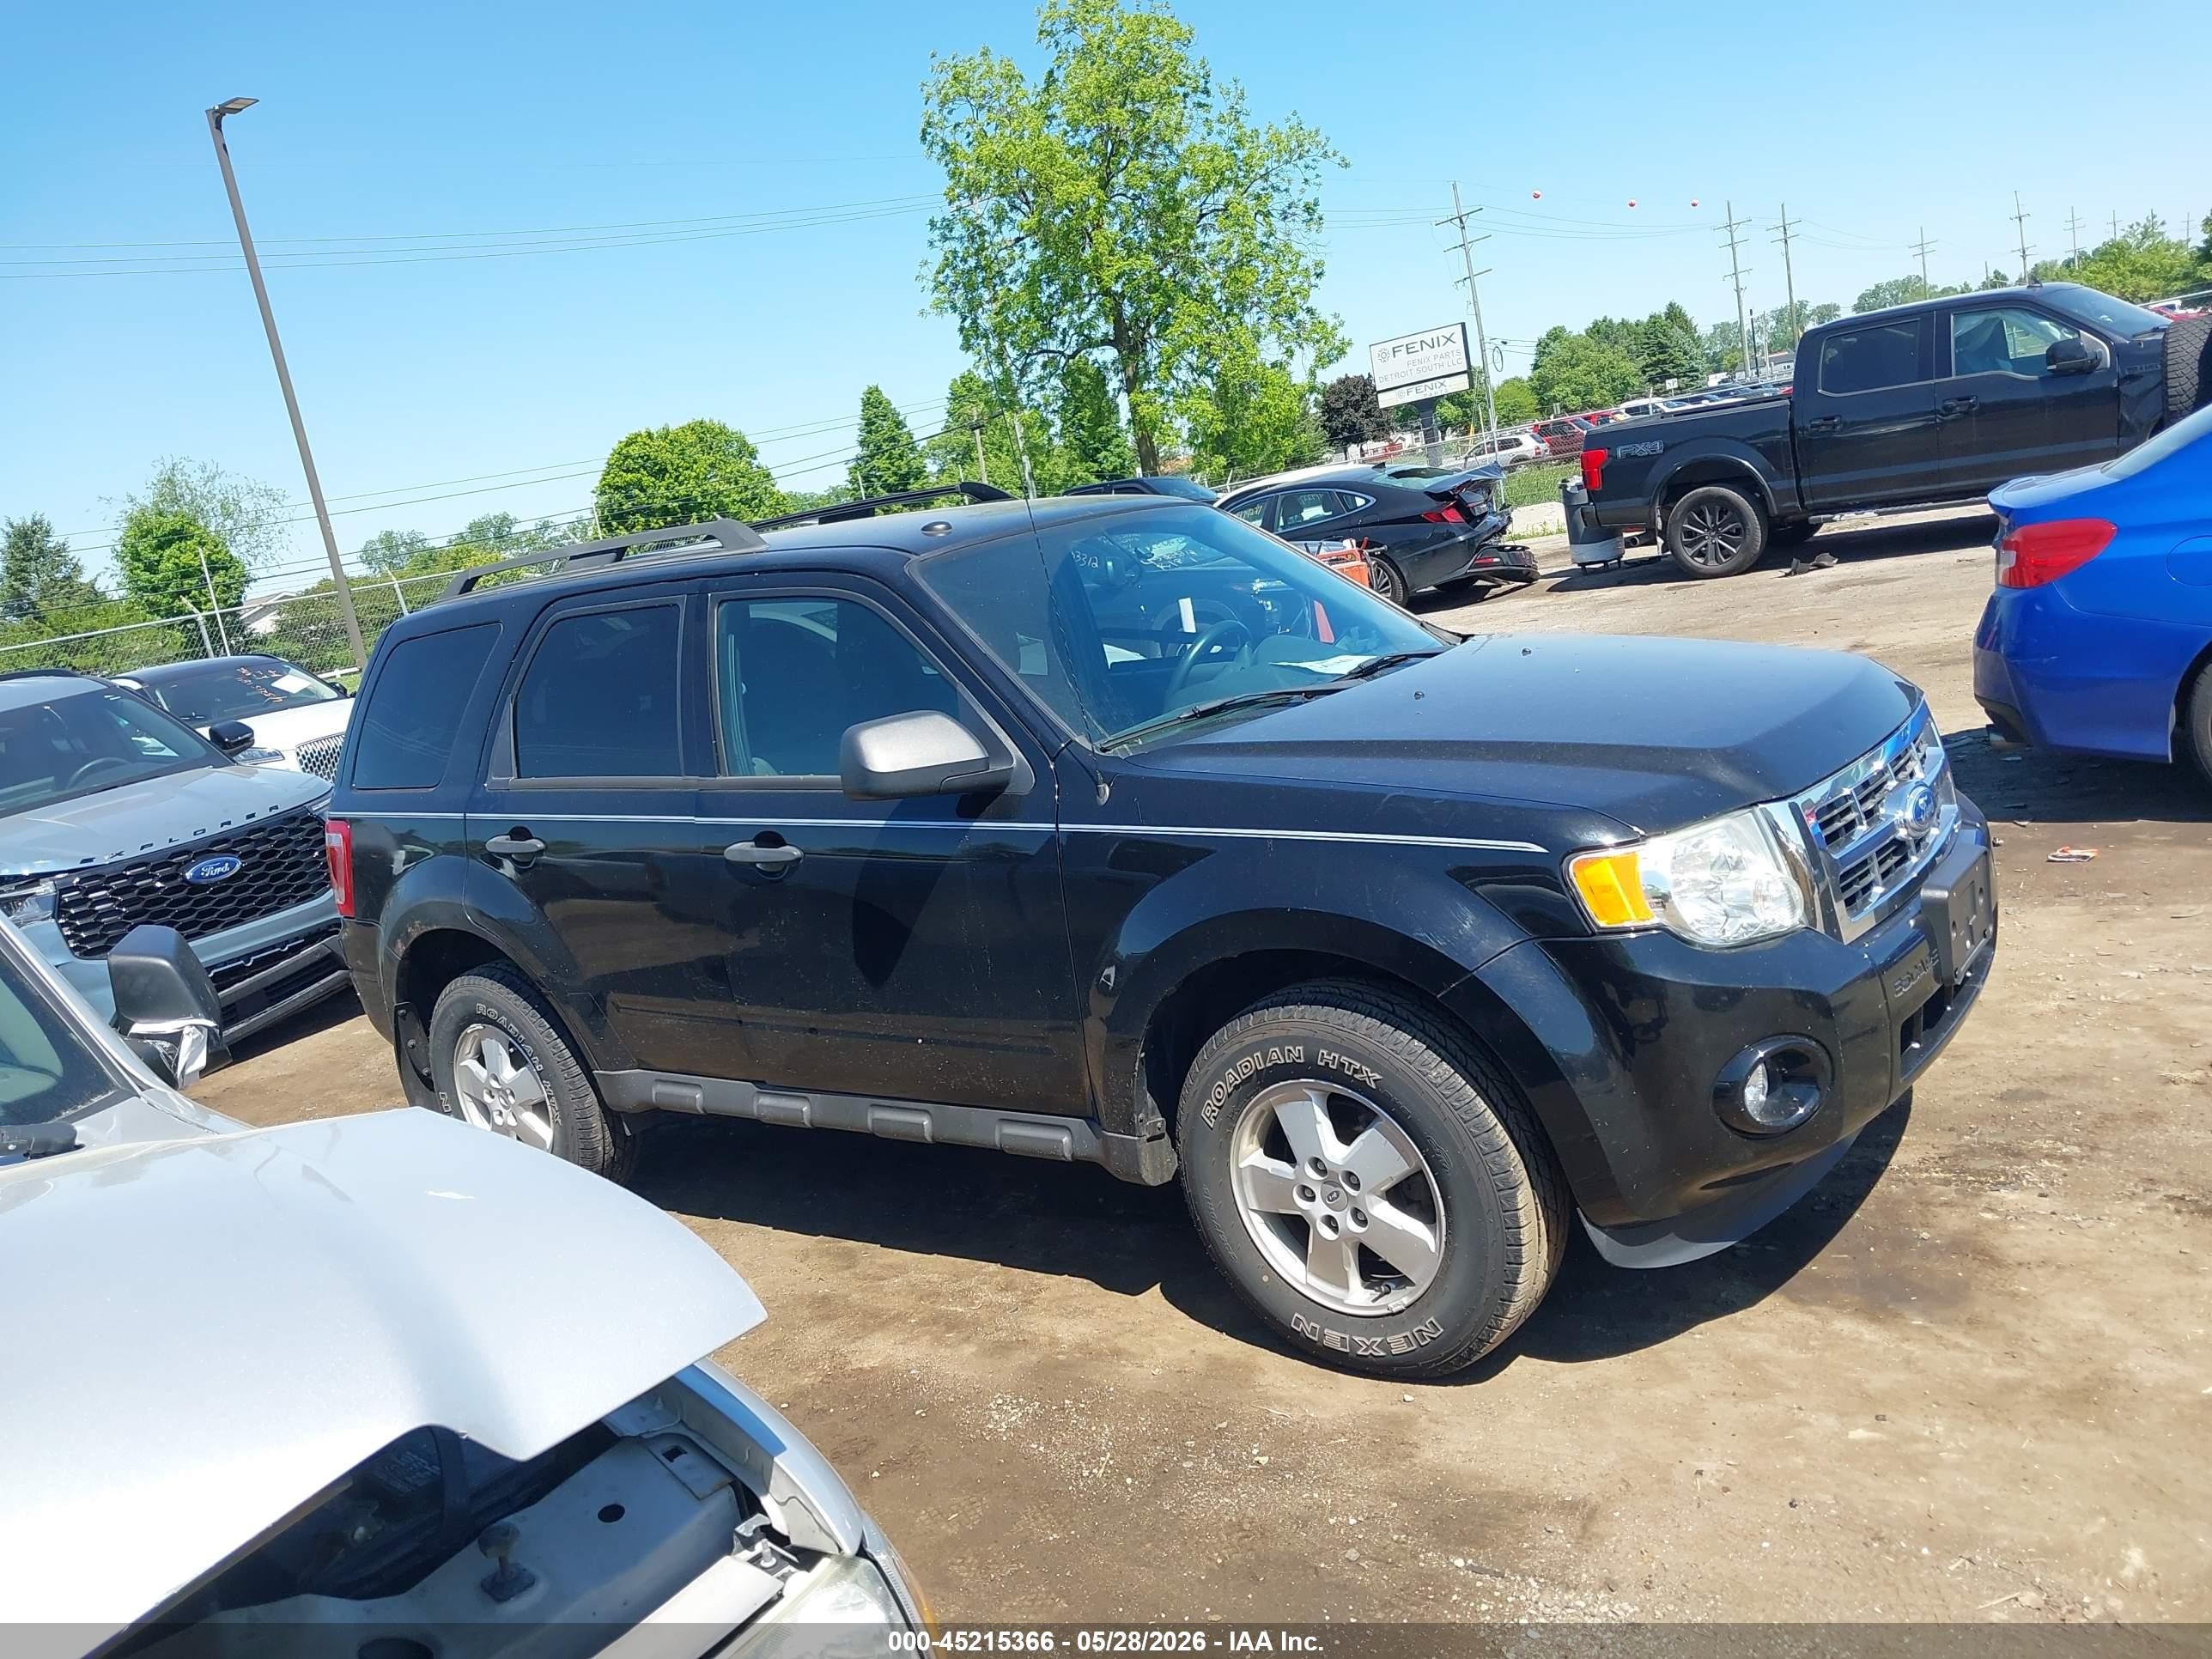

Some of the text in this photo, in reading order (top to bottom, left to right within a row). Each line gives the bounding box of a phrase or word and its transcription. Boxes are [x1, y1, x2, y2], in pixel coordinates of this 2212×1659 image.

[1392, 332, 1456, 358] FENIX
[1407, 349, 1462, 367] FENIX PARTS
[1378, 357, 1463, 384] DETROIT SOUTH LLC
[1407, 380, 1447, 396] FENIX
[1616, 440, 1664, 459] FX4
[476, 1003, 544, 1072] ROADIAN
[1200, 1045, 1304, 1130] ROADIAN
[1317, 1048, 1383, 1089] HTX
[1291, 1312, 1445, 1358] NEXEN
